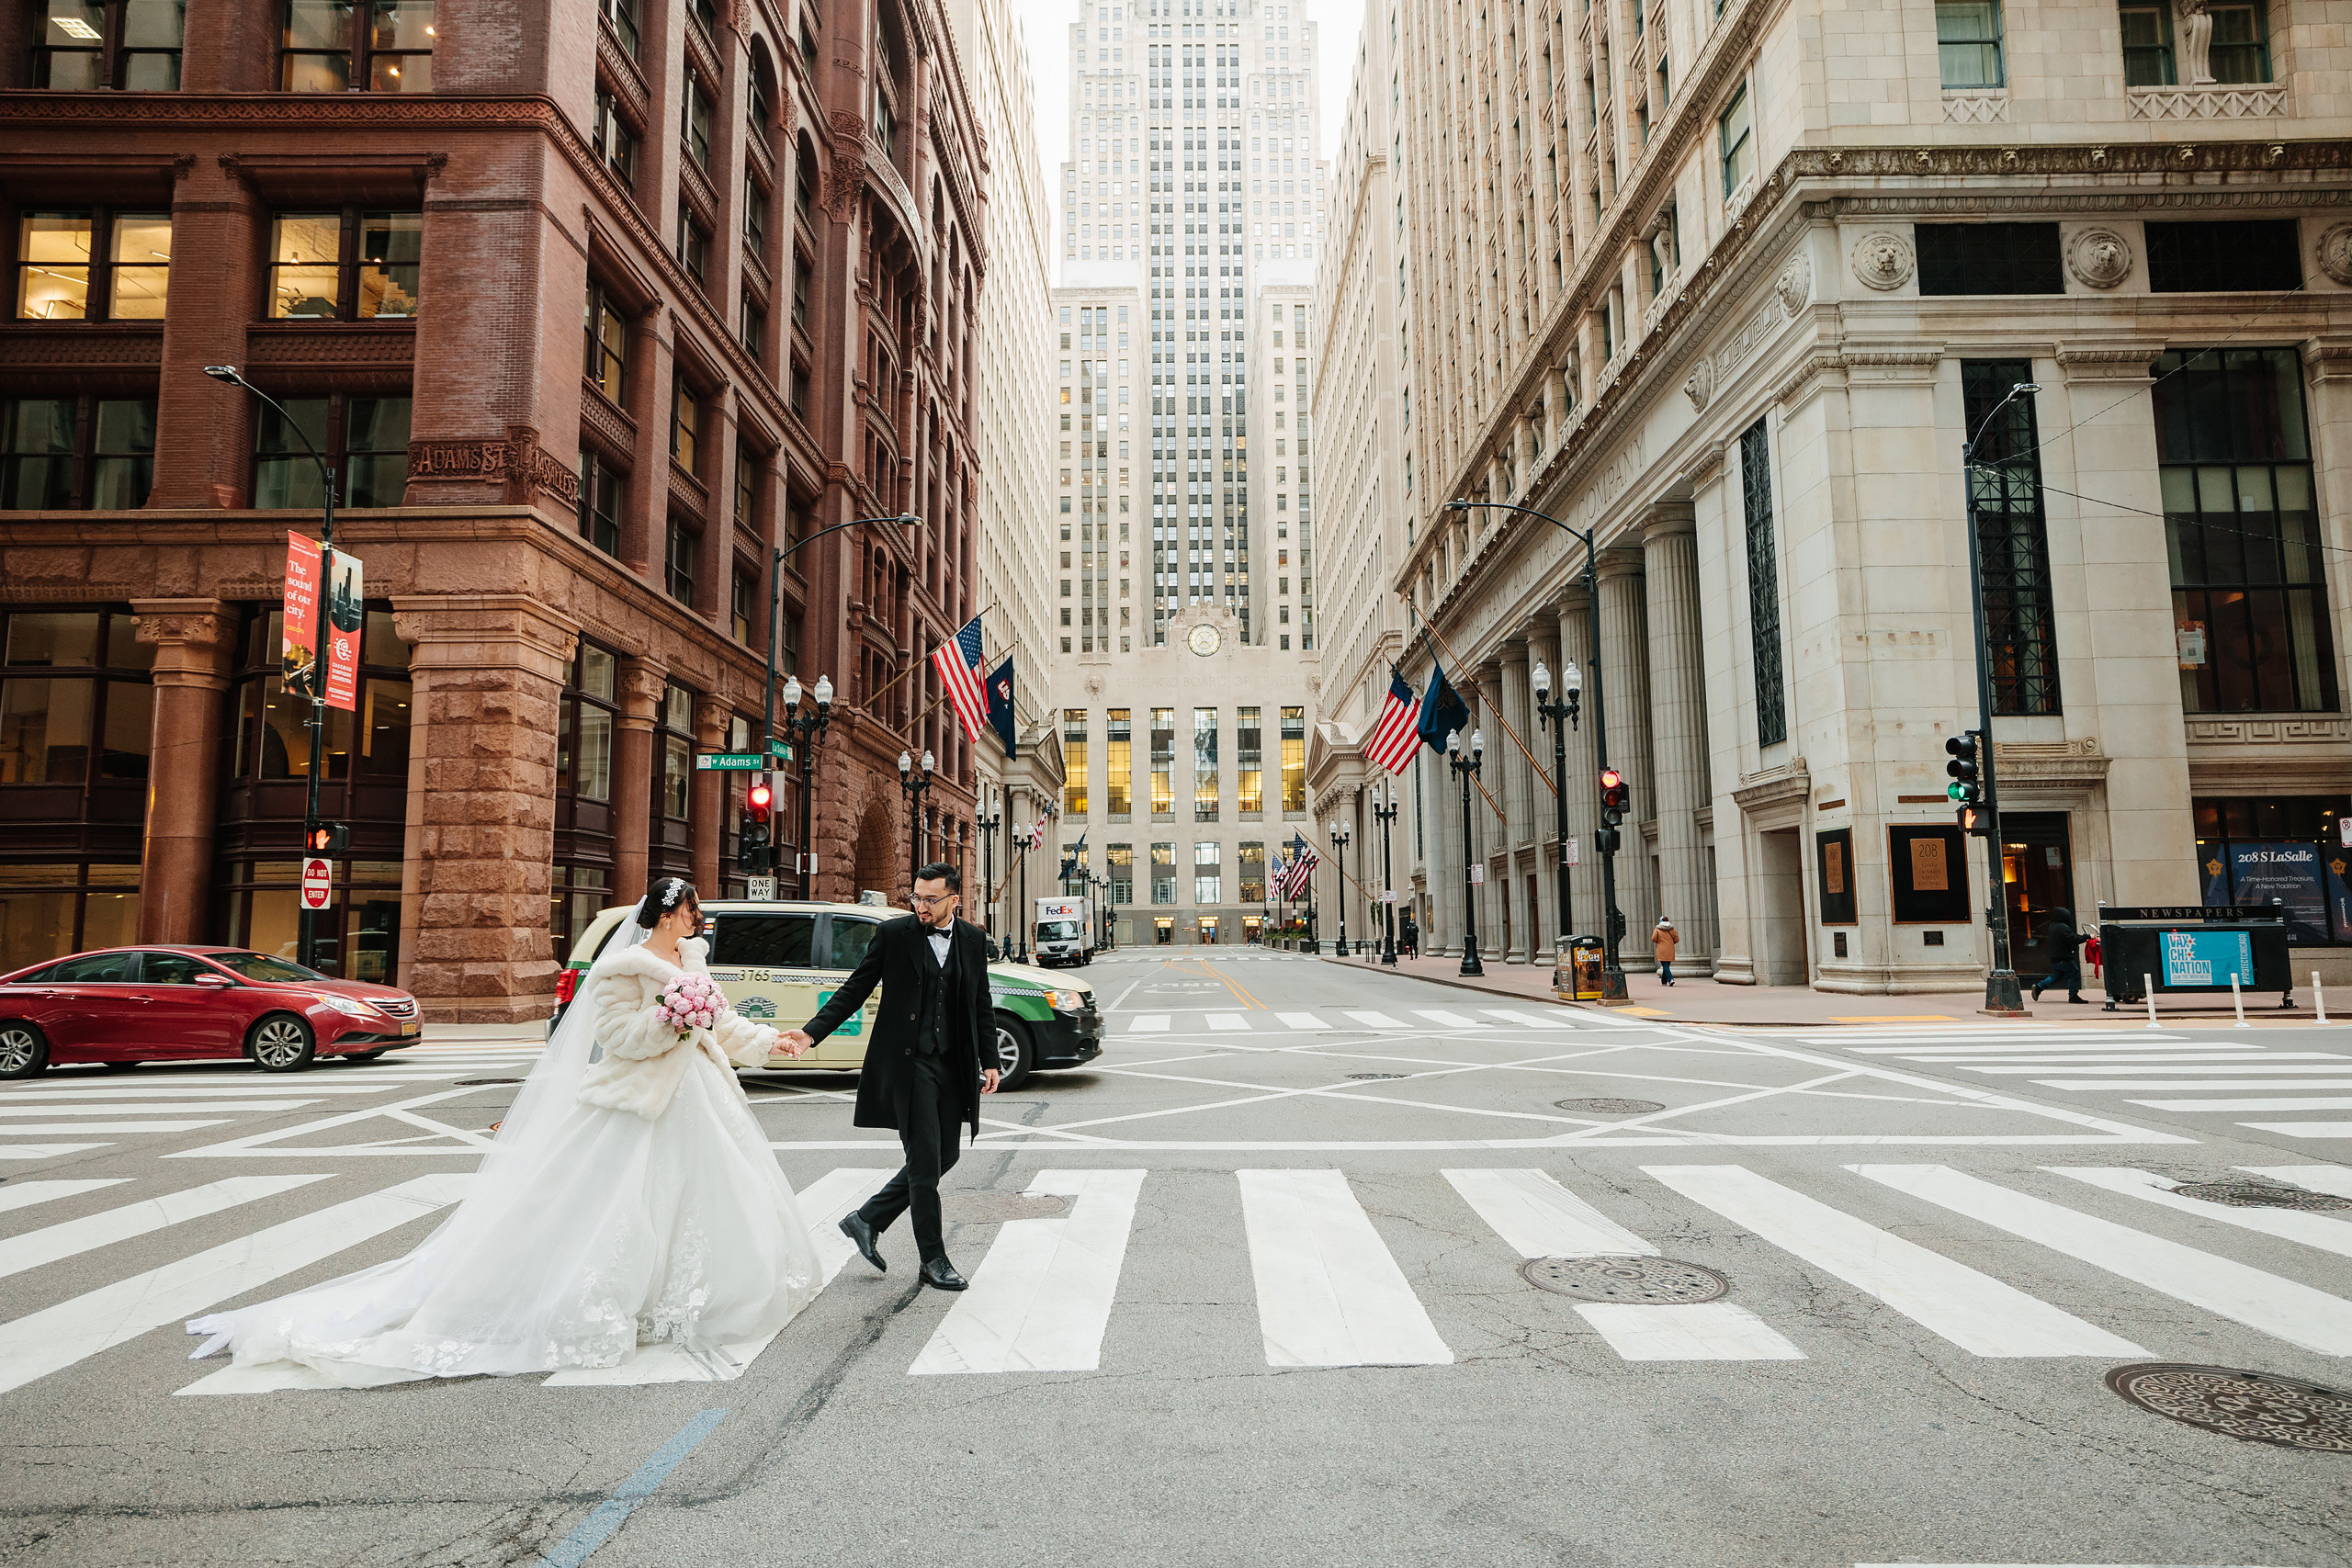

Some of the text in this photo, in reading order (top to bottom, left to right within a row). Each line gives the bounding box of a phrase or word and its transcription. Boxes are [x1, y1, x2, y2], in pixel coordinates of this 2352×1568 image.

[419, 445, 504, 473] ADAMS ST
[1487, 588, 1510, 625] BANK
[1514, 558, 1532, 594] AND
[1538, 513, 1571, 570] TRUST
[1577, 430, 1646, 530] COMPANY
[289, 560, 307, 575] The
[288, 577, 312, 592] sound
[287, 591, 311, 605] of our
[287, 604, 305, 619] city.
[1116, 675, 1298, 688] CHICAGO BOARD OF TRADE
[719, 757, 751, 766] Adams
[1919, 844, 1938, 857] 208
[2238, 851, 2312, 863] 208 S LaSalle
[752, 879, 770, 887] ONE
[309, 890, 324, 898] ENTER
[752, 888, 770, 897] WAY
[1046, 906, 1073, 915] FedEx
[2140, 908, 2244, 919] NEWSPAPERS
[2169, 935, 2189, 947] VAX
[2238, 933, 2250, 985] #PROTECTCHICAGO
[2172, 962, 2211, 974] NATION
[739, 969, 770, 982] 3765
